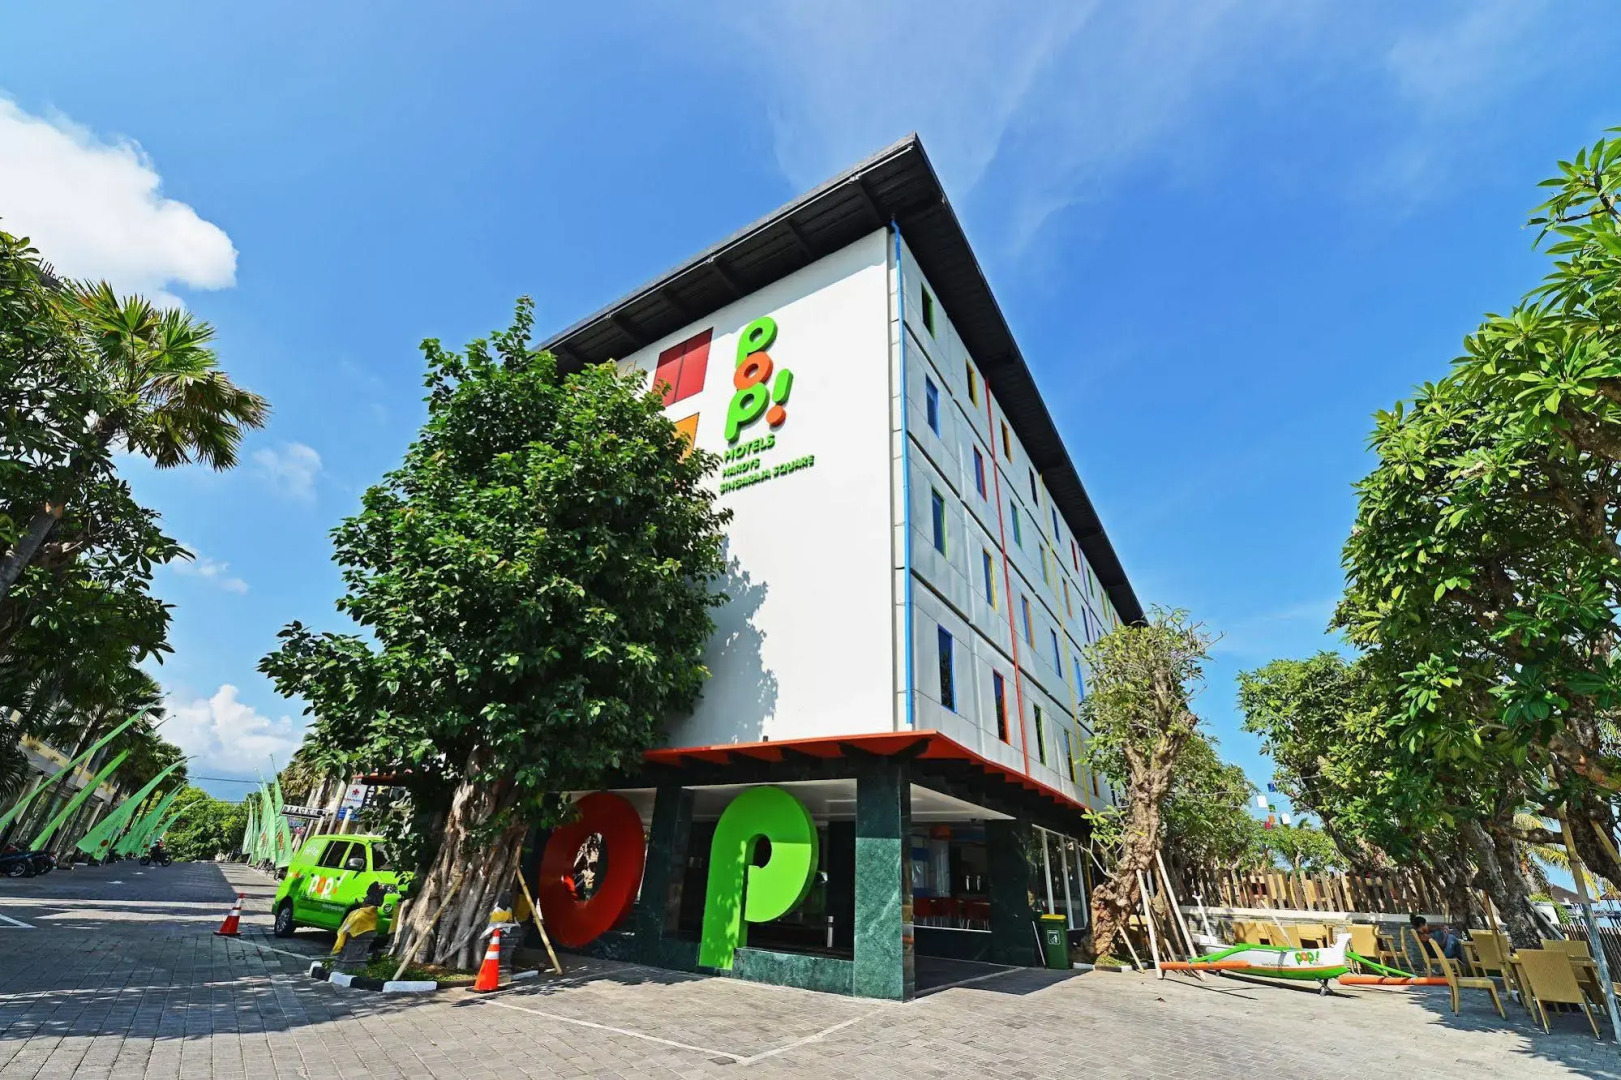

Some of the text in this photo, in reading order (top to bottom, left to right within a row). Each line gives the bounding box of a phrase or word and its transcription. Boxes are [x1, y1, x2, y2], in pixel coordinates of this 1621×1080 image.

[723, 433, 775, 463] HOTELS
[719, 454, 815, 495] SINGARAJA SQUARE
[722, 458, 760, 478] HARDYS
